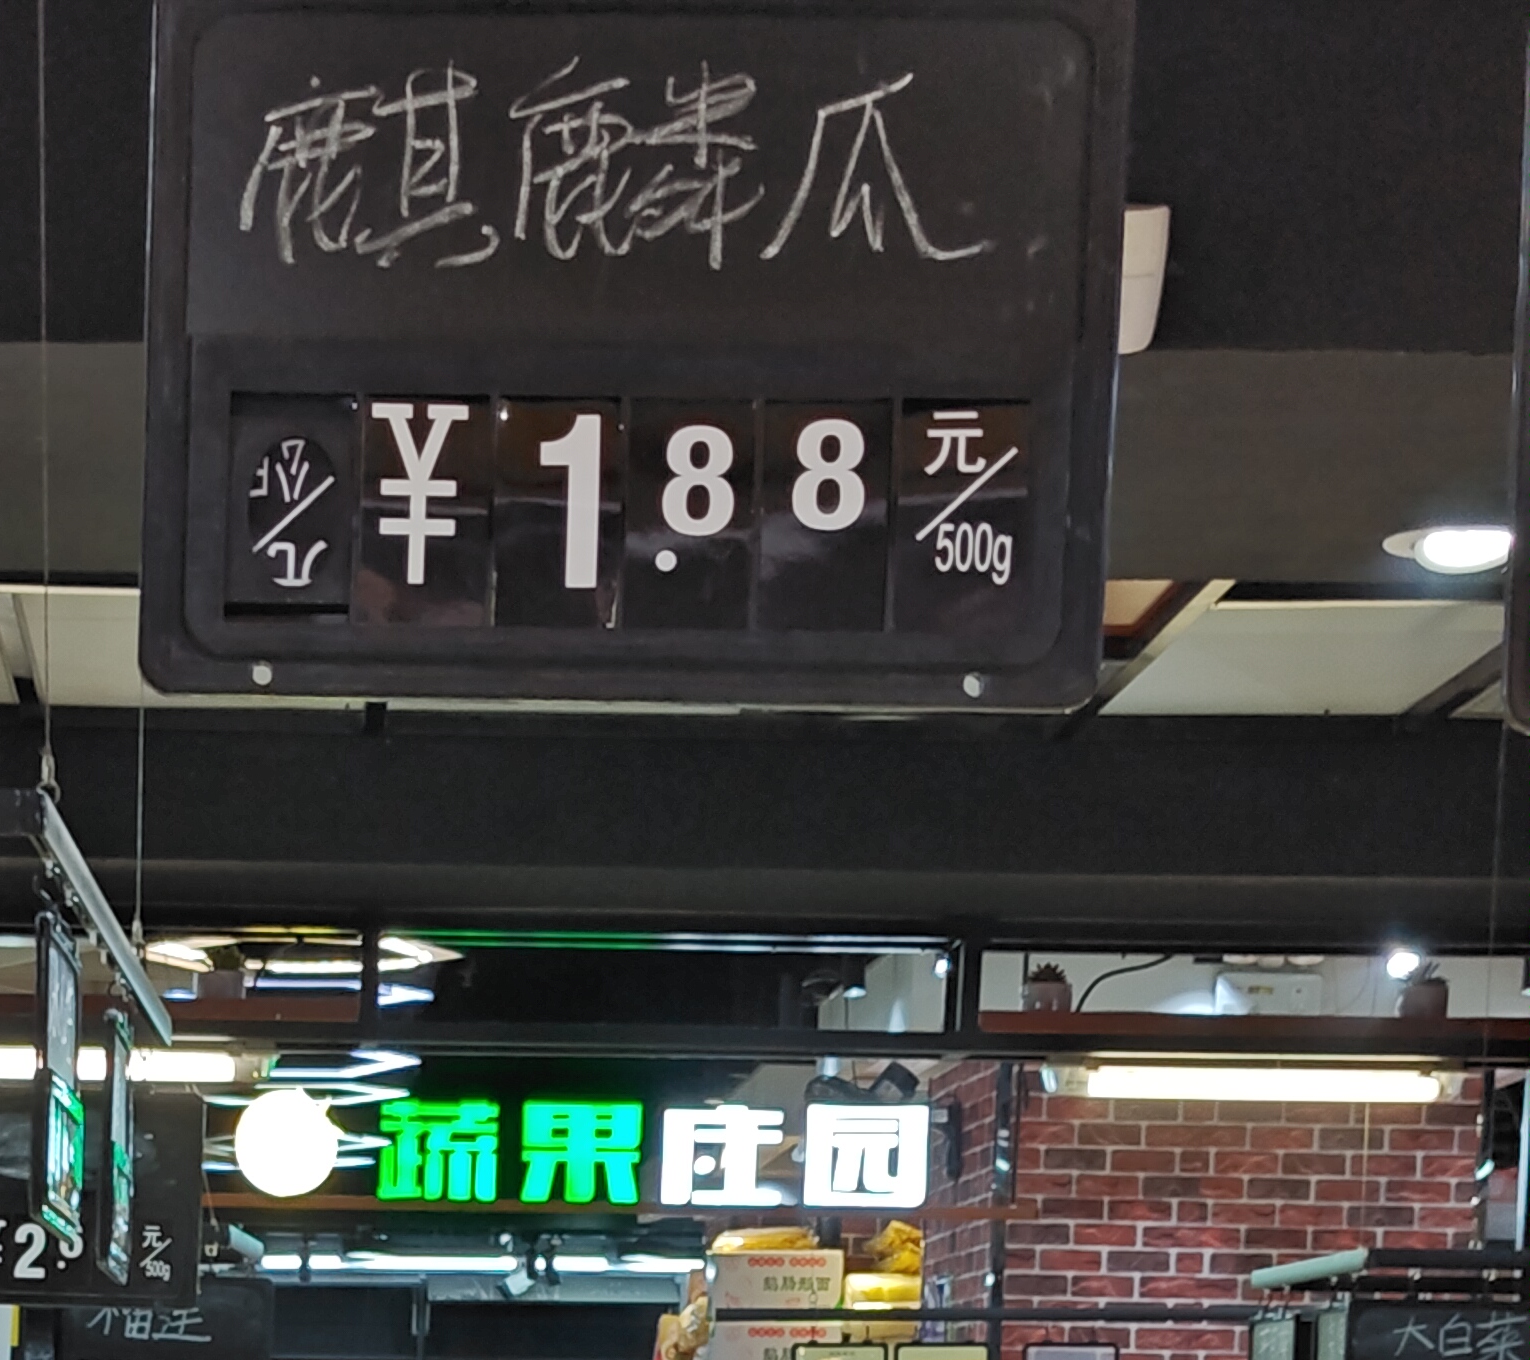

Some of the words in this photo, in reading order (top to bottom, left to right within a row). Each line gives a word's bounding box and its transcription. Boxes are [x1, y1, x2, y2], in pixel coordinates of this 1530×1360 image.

[241, 57, 998, 270] 麒麟瓜
[375, 1098, 932, 1209] 蔬果庄园
